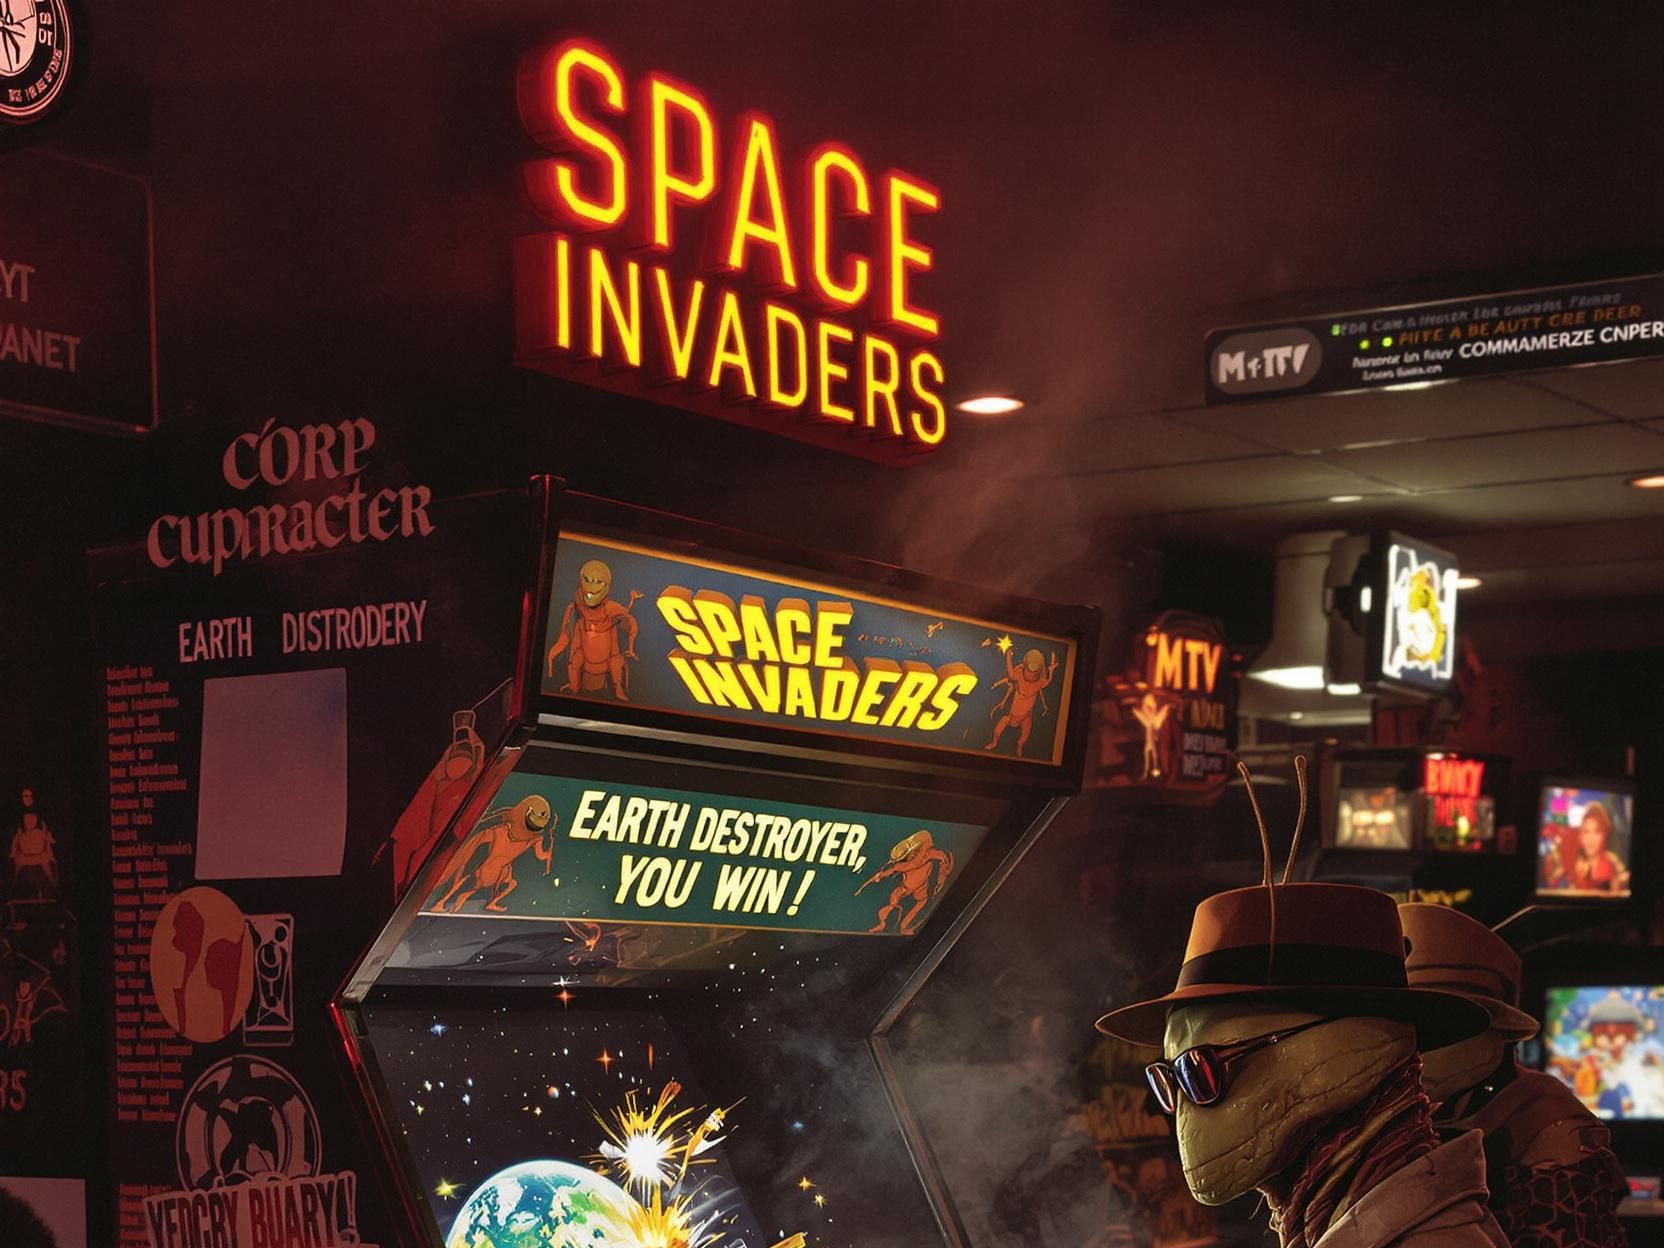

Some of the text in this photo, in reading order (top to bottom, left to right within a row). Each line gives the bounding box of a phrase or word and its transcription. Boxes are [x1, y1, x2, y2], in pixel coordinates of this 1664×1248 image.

[553, 46, 940, 336] SPACE
[0, 321, 81, 372] ANET
[555, 238, 947, 446] INVADERS
[178, 600, 428, 664] EARTH DISTRODERY
[656, 587, 854, 669] SPACE
[1154, 632, 1222, 695] MTV
[667, 652, 978, 731] INVADERS
[569, 790, 868, 874] EARTH DESTROYER,
[614, 854, 703, 909] YOU
